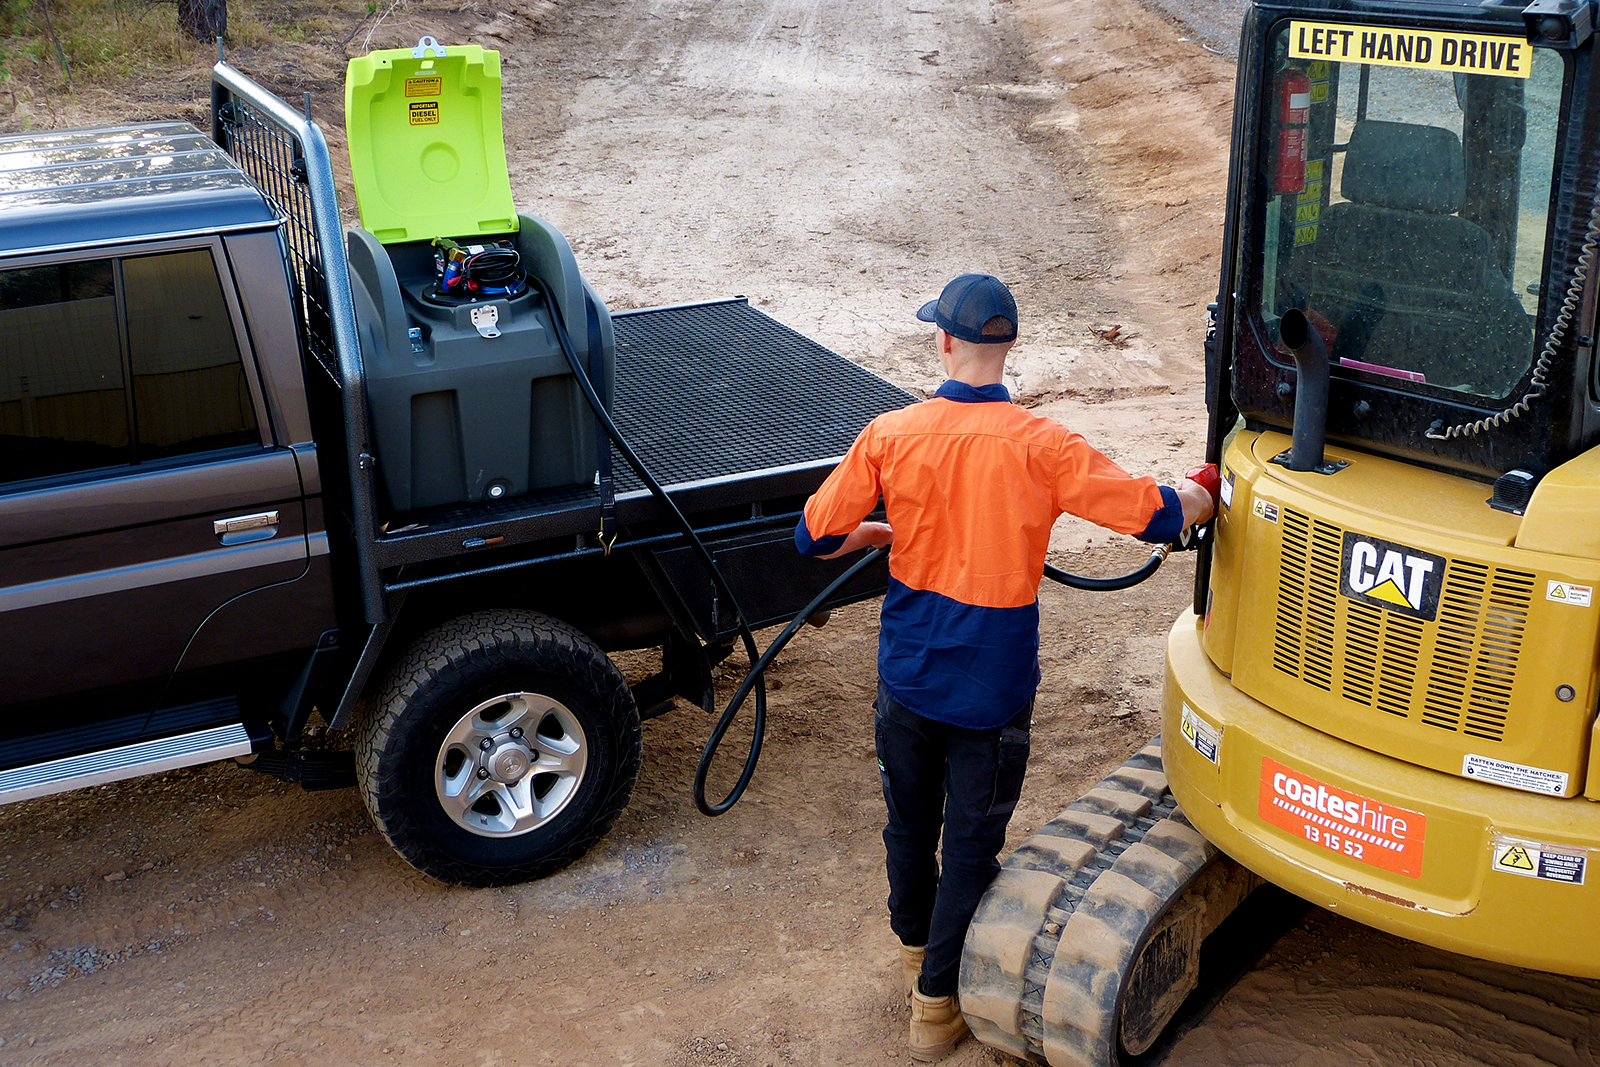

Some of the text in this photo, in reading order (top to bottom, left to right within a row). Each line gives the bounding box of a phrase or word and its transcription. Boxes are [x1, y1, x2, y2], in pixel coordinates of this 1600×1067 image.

[1298, 27, 1522, 72] LEFT HAND DRIVE
[1349, 541, 1434, 611] CAT
[1470, 757, 1495, 767] BATTEN
[1495, 762, 1515, 771] DOWN
[1530, 770, 1562, 780] HATCHES!
[1303, 824, 1364, 860] 13 15 52
